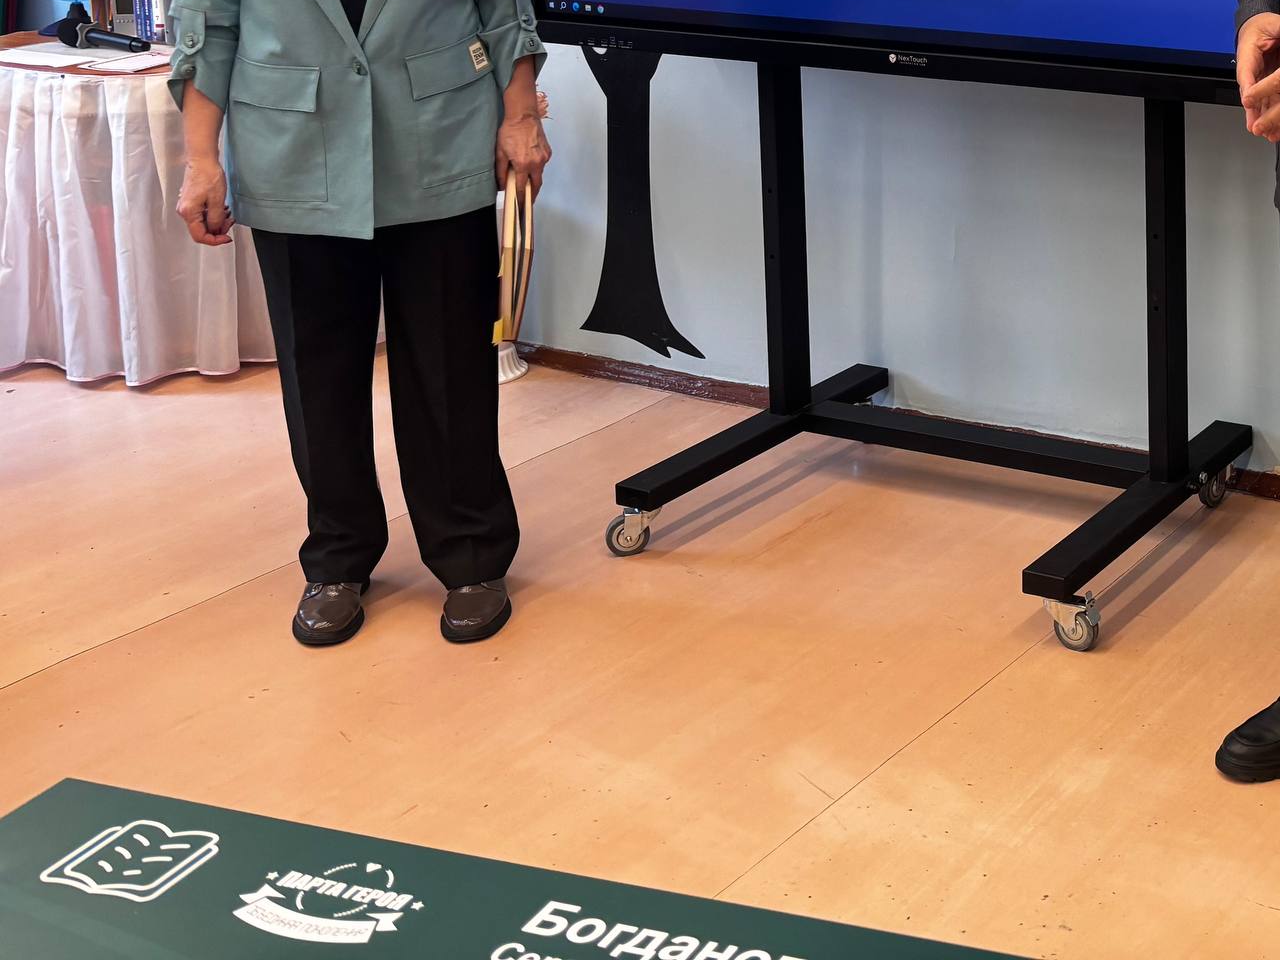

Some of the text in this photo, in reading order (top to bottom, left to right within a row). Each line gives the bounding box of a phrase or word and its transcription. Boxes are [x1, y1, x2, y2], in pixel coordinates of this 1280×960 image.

[898, 54, 928, 63] NexTouch
[276, 870, 413, 911] ПАРТА ГЕРОЯ
